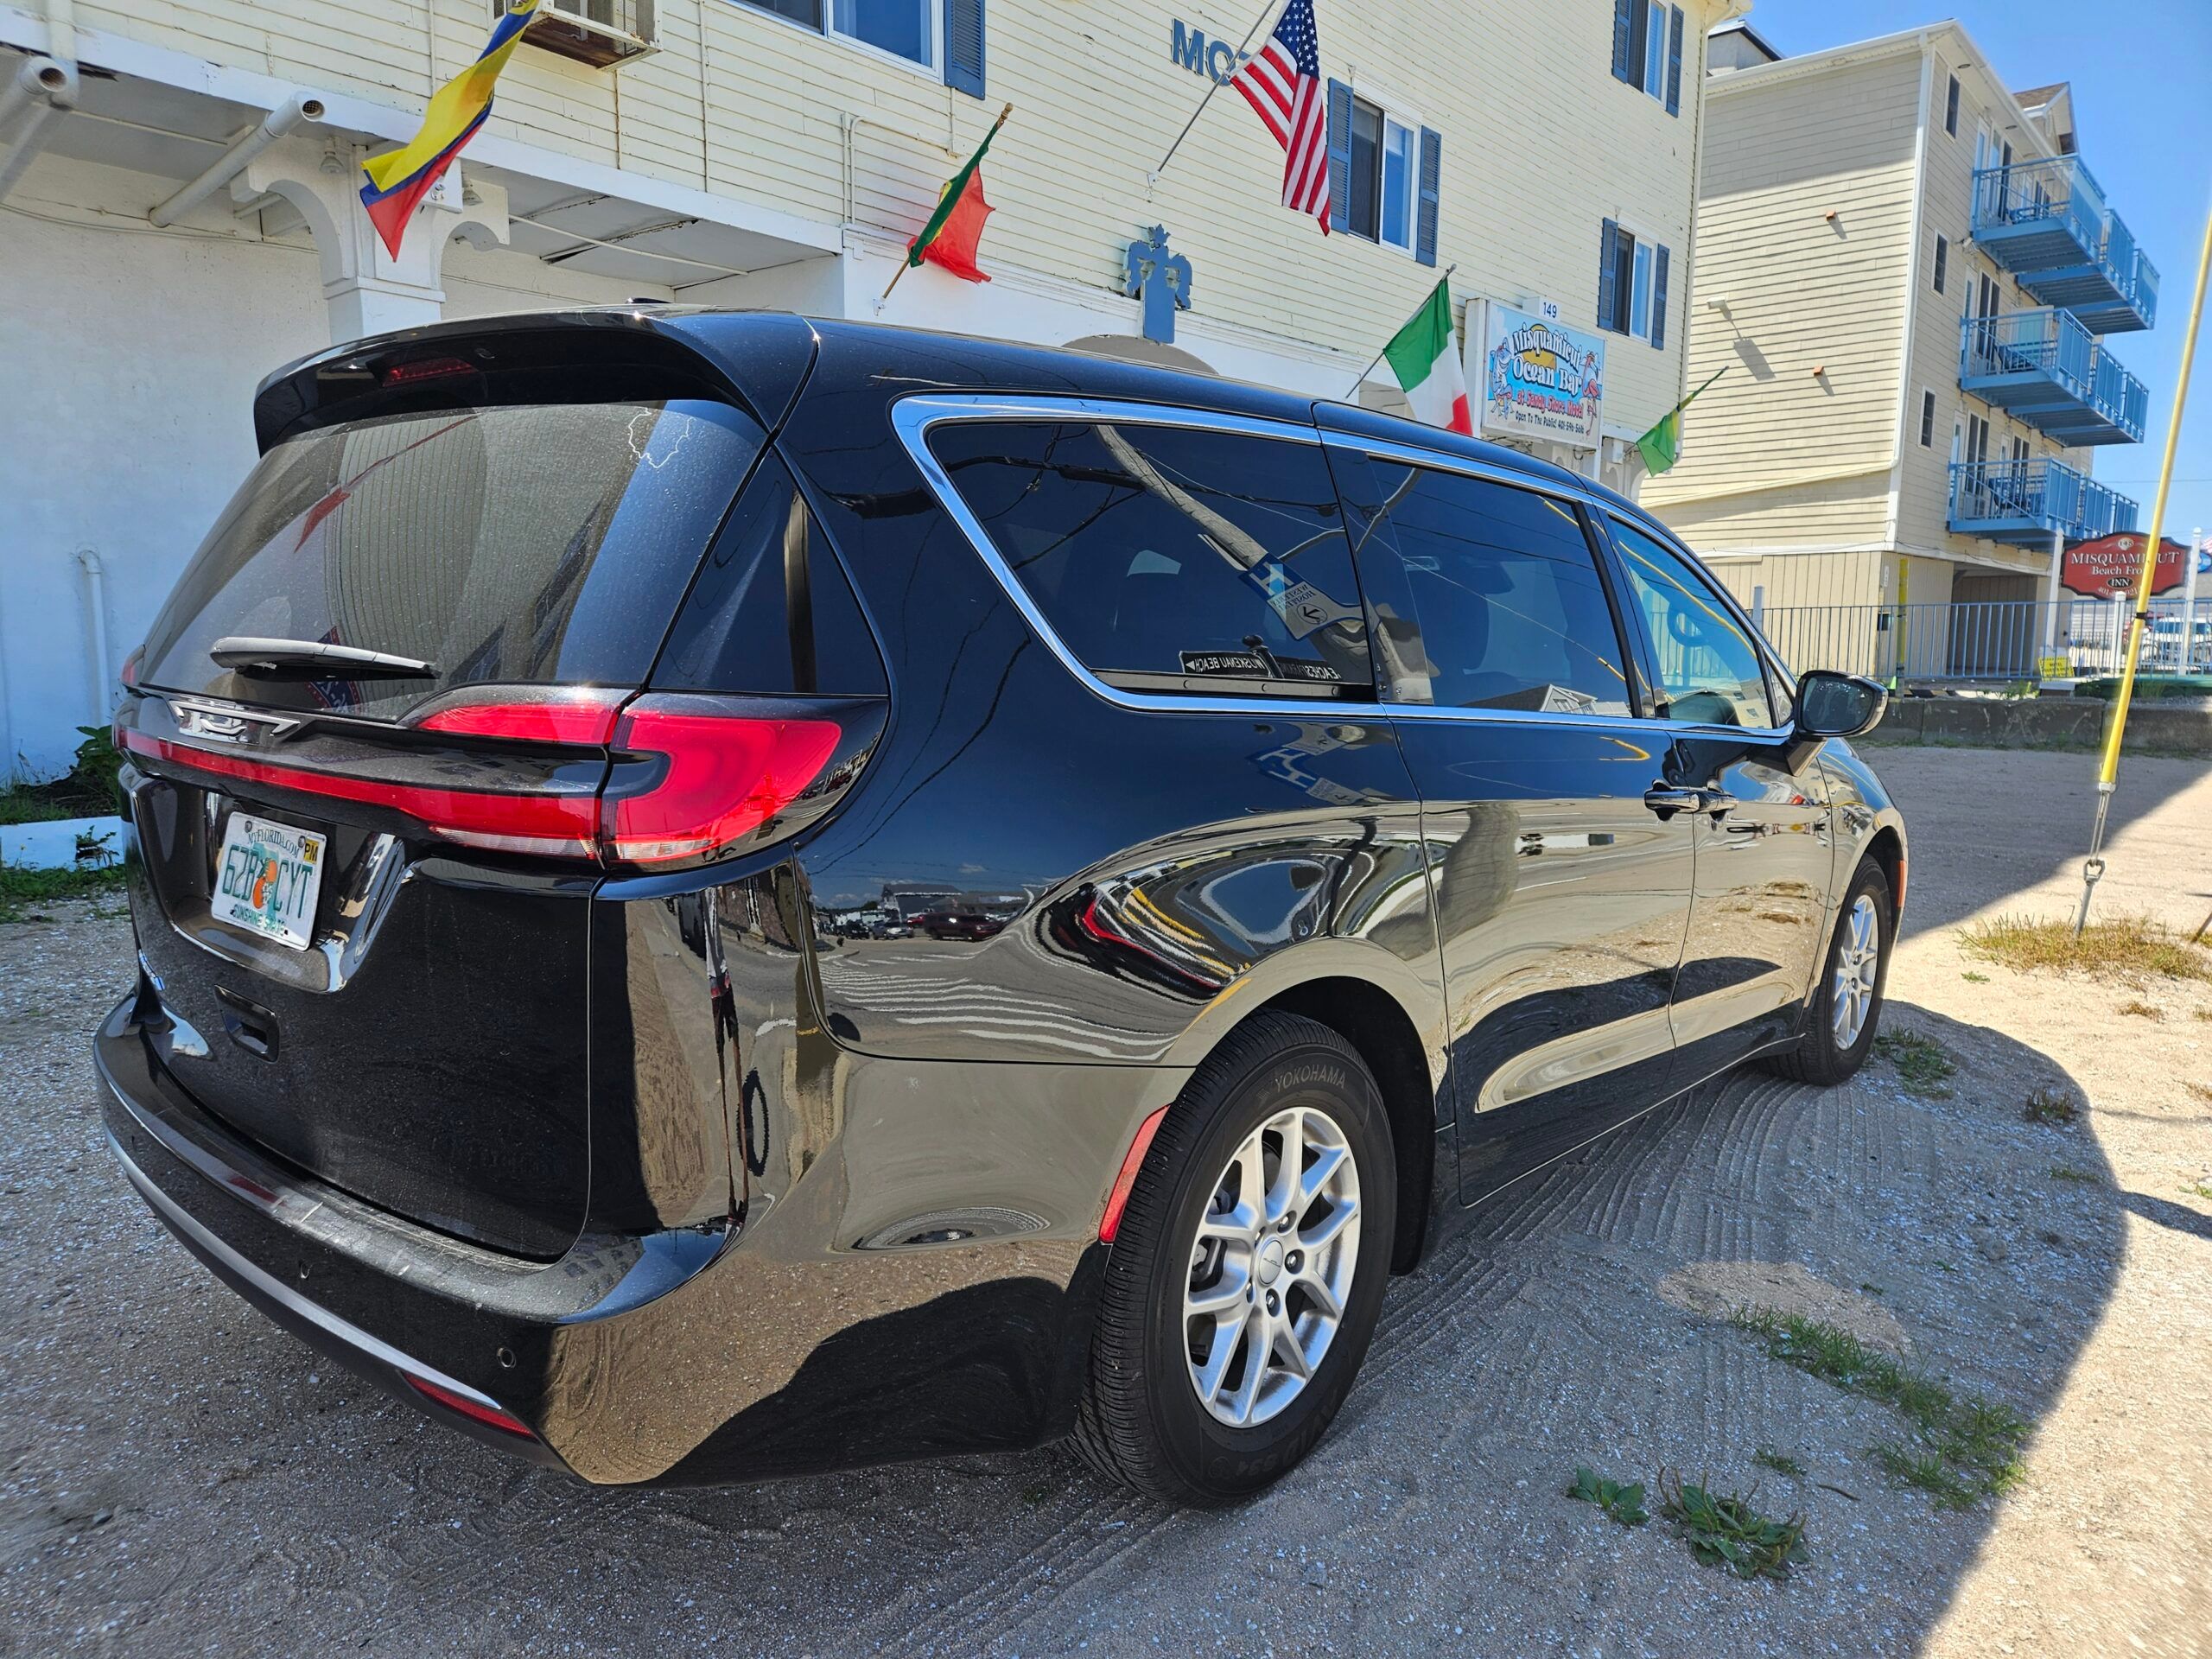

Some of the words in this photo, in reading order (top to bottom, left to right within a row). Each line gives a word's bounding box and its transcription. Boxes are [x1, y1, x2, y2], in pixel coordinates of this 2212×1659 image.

[1172, 17, 1252, 87] MO
[1543, 302, 1557, 318] 149
[1512, 322, 1582, 373] Misquamicut
[1513, 355, 1554, 388] Ocean
[1559, 367, 1583, 397] Bar
[1516, 410, 1526, 423] Open
[1528, 412, 1533, 423] To
[1517, 389, 1524, 405] at
[1527, 390, 1546, 414] Sandy
[1548, 395, 1566, 415] Shore
[1567, 400, 1584, 420] Motel
[2071, 551, 2180, 566] MISQUAMIUT
[2092, 566, 2122, 575] Beach
[2126, 566, 2142, 575] Fro
[2110, 578, 2130, 588] INN
[248, 828, 300, 858] MYFLORIDA.COM
[305, 842, 320, 862] PM
[273, 859, 313, 919] CYT
[1274, 1064, 1346, 1092] YOKOHAMA
